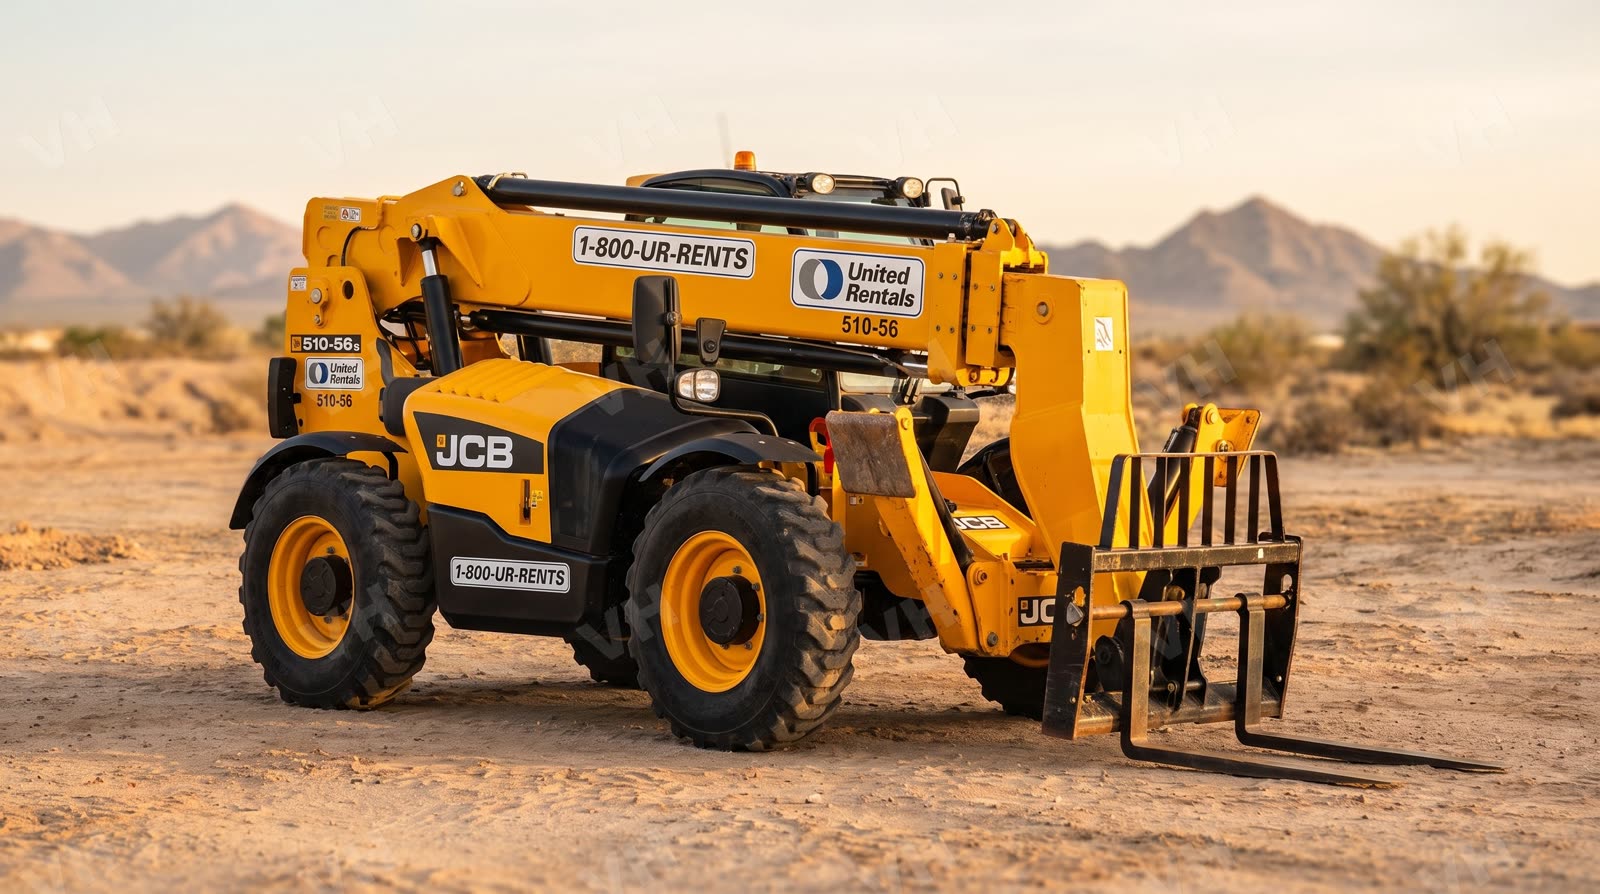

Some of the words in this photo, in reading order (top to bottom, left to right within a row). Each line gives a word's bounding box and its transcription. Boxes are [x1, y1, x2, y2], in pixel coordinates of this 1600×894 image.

[579, 235, 749, 269] 1-800-UR-RENTS
[848, 262, 911, 285] United
[845, 283, 915, 307] Rentals
[842, 315, 898, 338] 510-56
[303, 337, 360, 351] 510-56s
[330, 363, 358, 373] United
[330, 374, 360, 385] Rentals
[317, 394, 352, 407] 510-56
[436, 434, 513, 469] JCB
[455, 564, 565, 586] 1-800-UR-RENTS
[1020, 598, 1055, 624] JC
